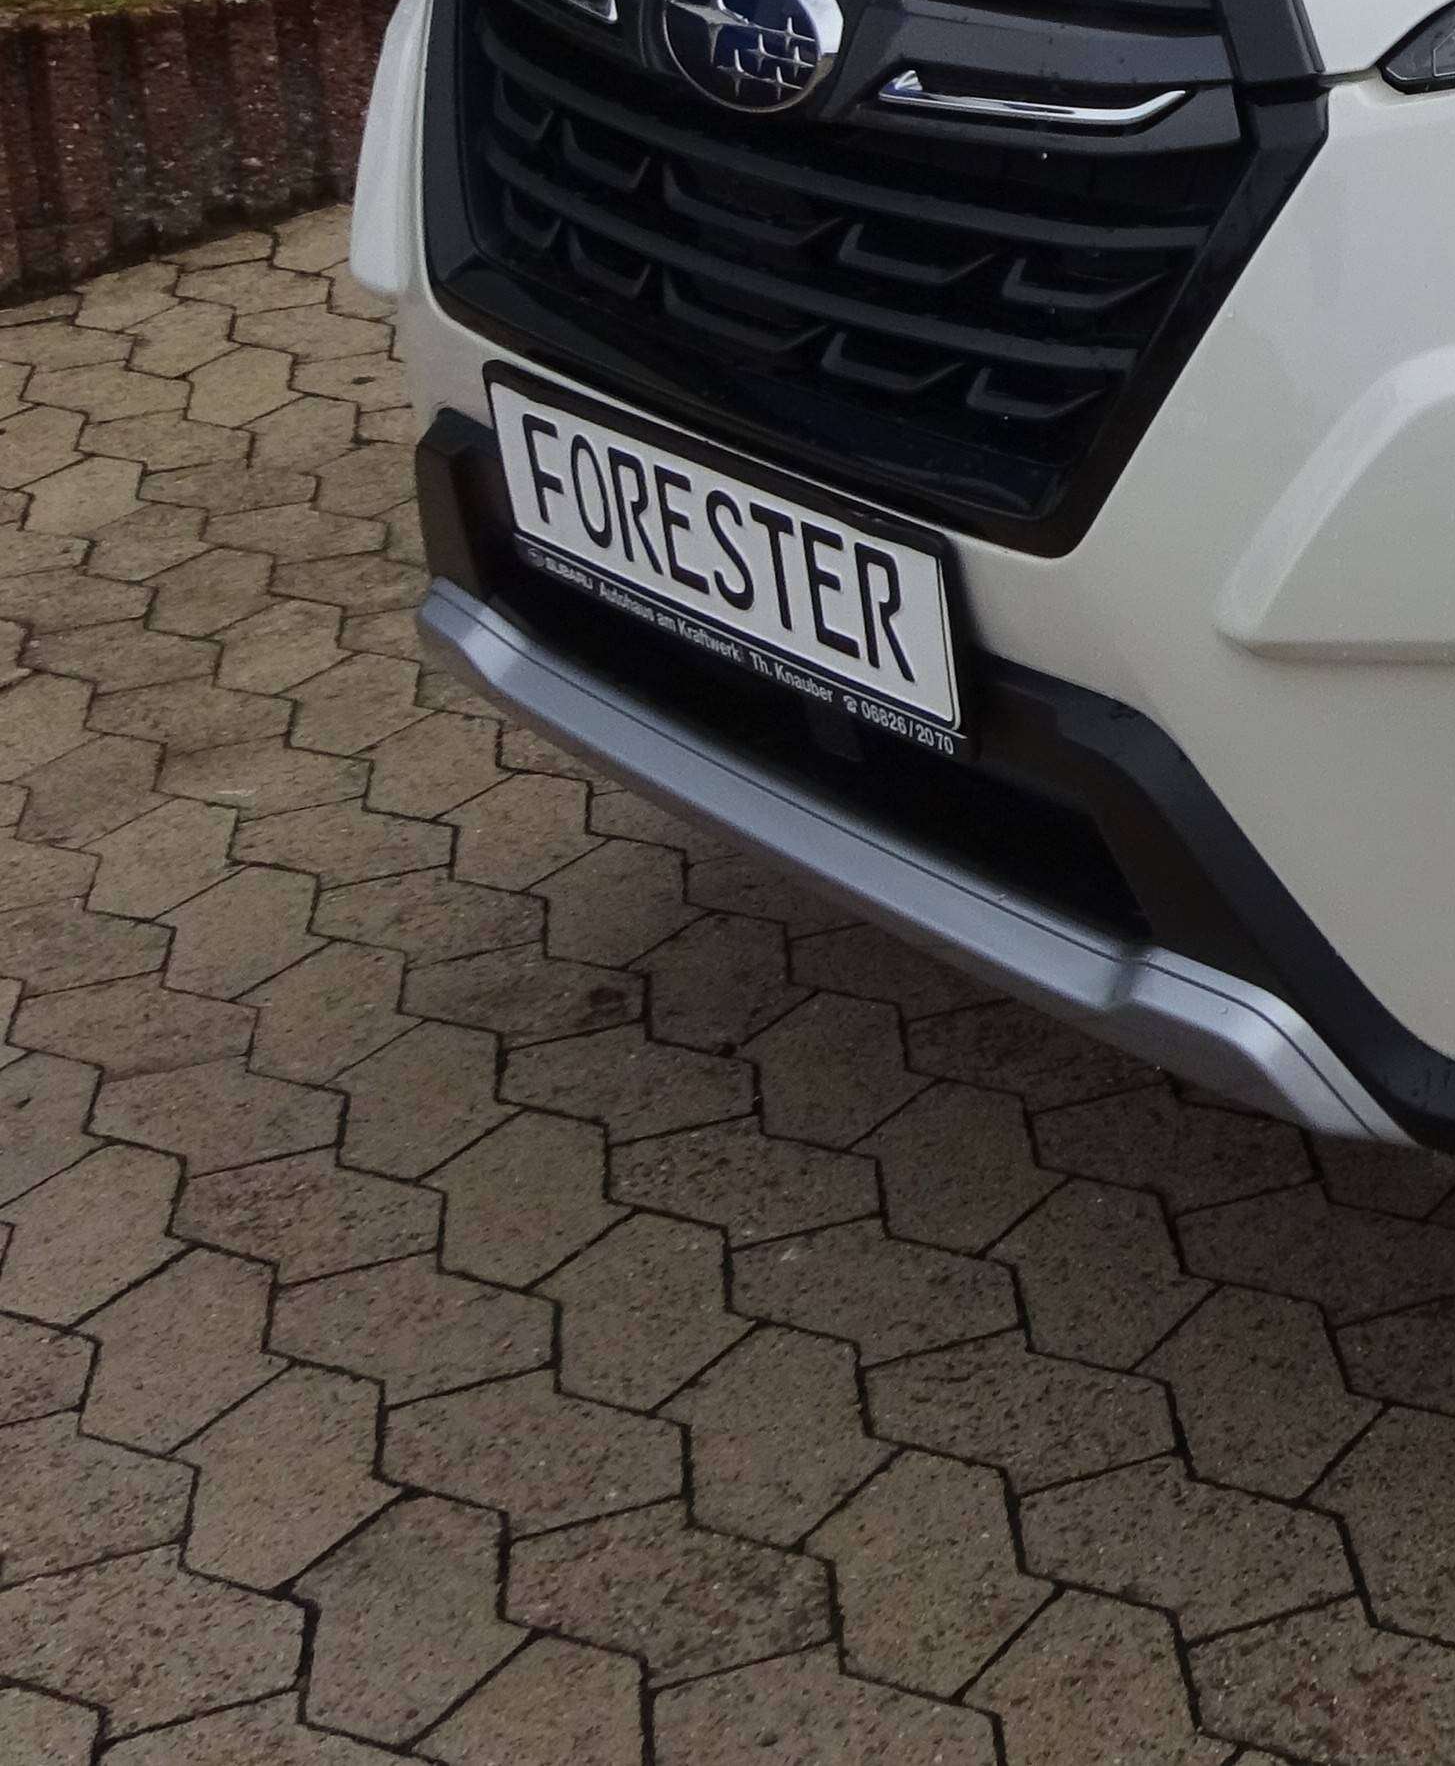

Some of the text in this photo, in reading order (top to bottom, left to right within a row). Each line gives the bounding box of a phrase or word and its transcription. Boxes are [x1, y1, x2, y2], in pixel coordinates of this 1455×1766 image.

[521, 413, 916, 683] FORESTER
[545, 557, 593, 590] SUBARU
[599, 582, 656, 622] Autohaus
[656, 612, 677, 633] am
[678, 618, 742, 662] Kraftwerk
[750, 651, 774, 676] Th.
[775, 662, 834, 703] Knauber
